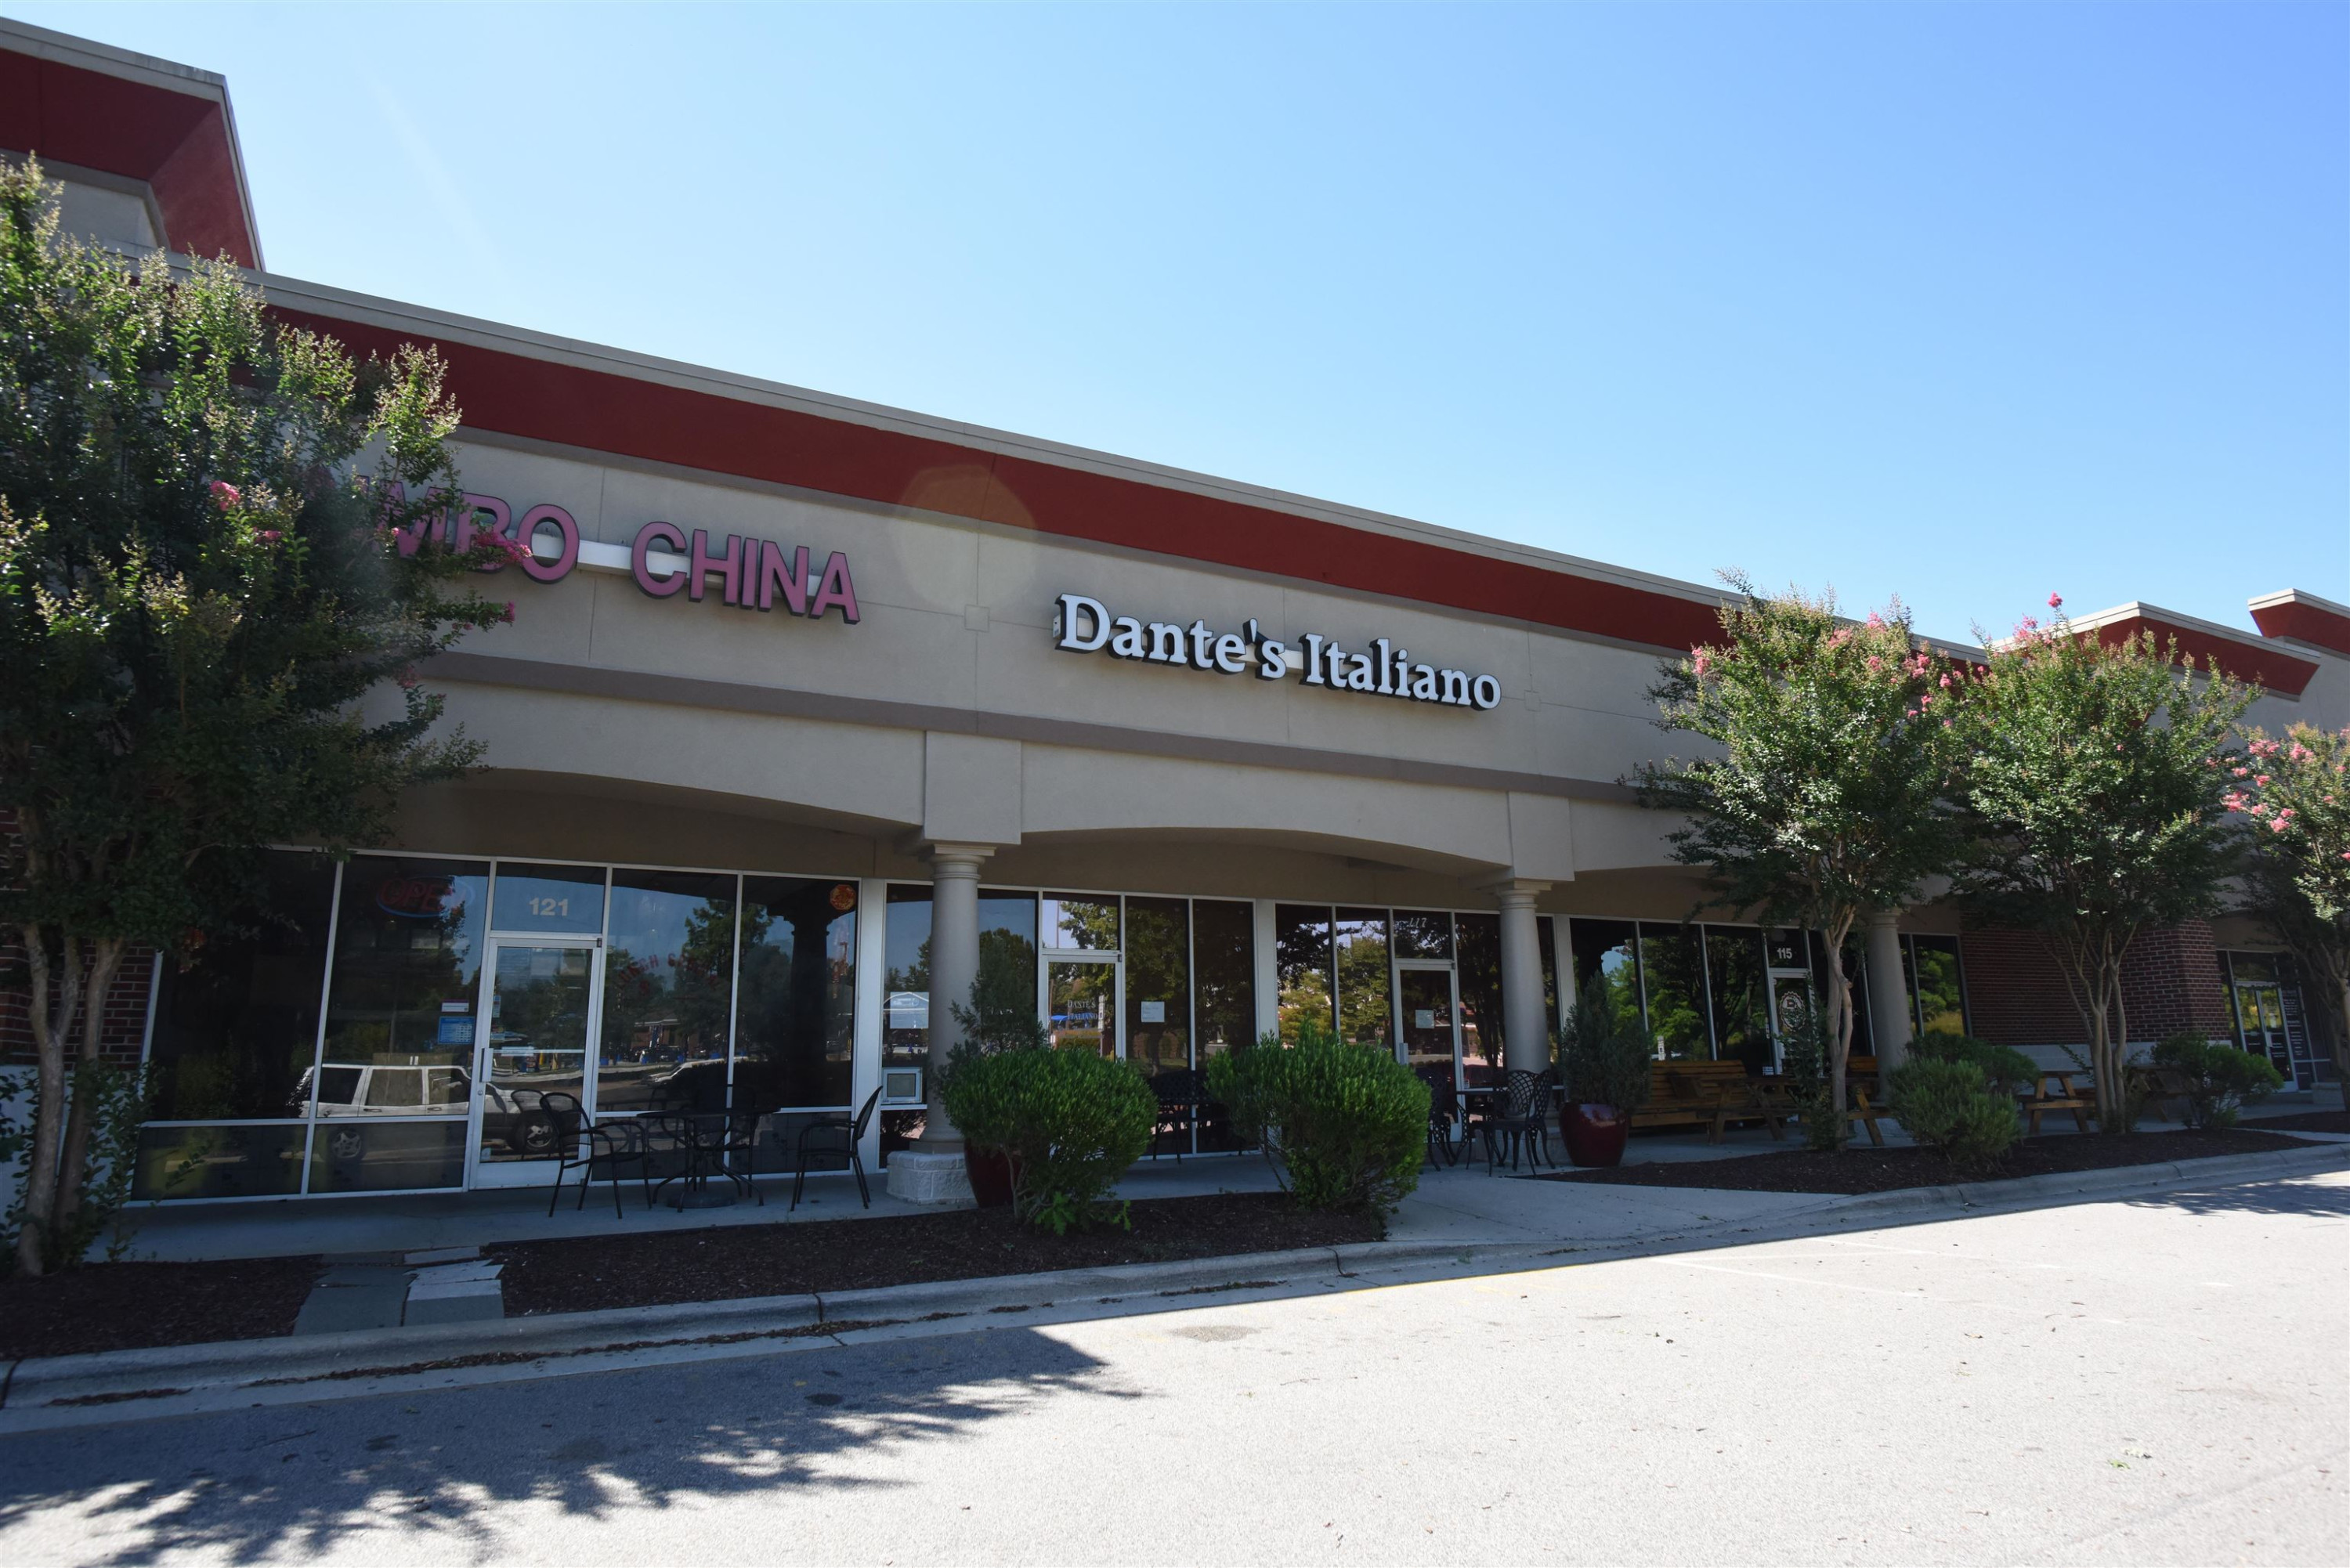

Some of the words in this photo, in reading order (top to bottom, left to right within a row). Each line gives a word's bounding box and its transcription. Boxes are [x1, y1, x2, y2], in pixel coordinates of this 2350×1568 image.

[631, 520, 861, 625] CHINA
[1055, 592, 1287, 681] Dante's
[1298, 632, 1502, 711] Italiano
[529, 897, 569, 916] 121
[1409, 917, 1427, 928] 117
[1777, 947, 1793, 959] 115
